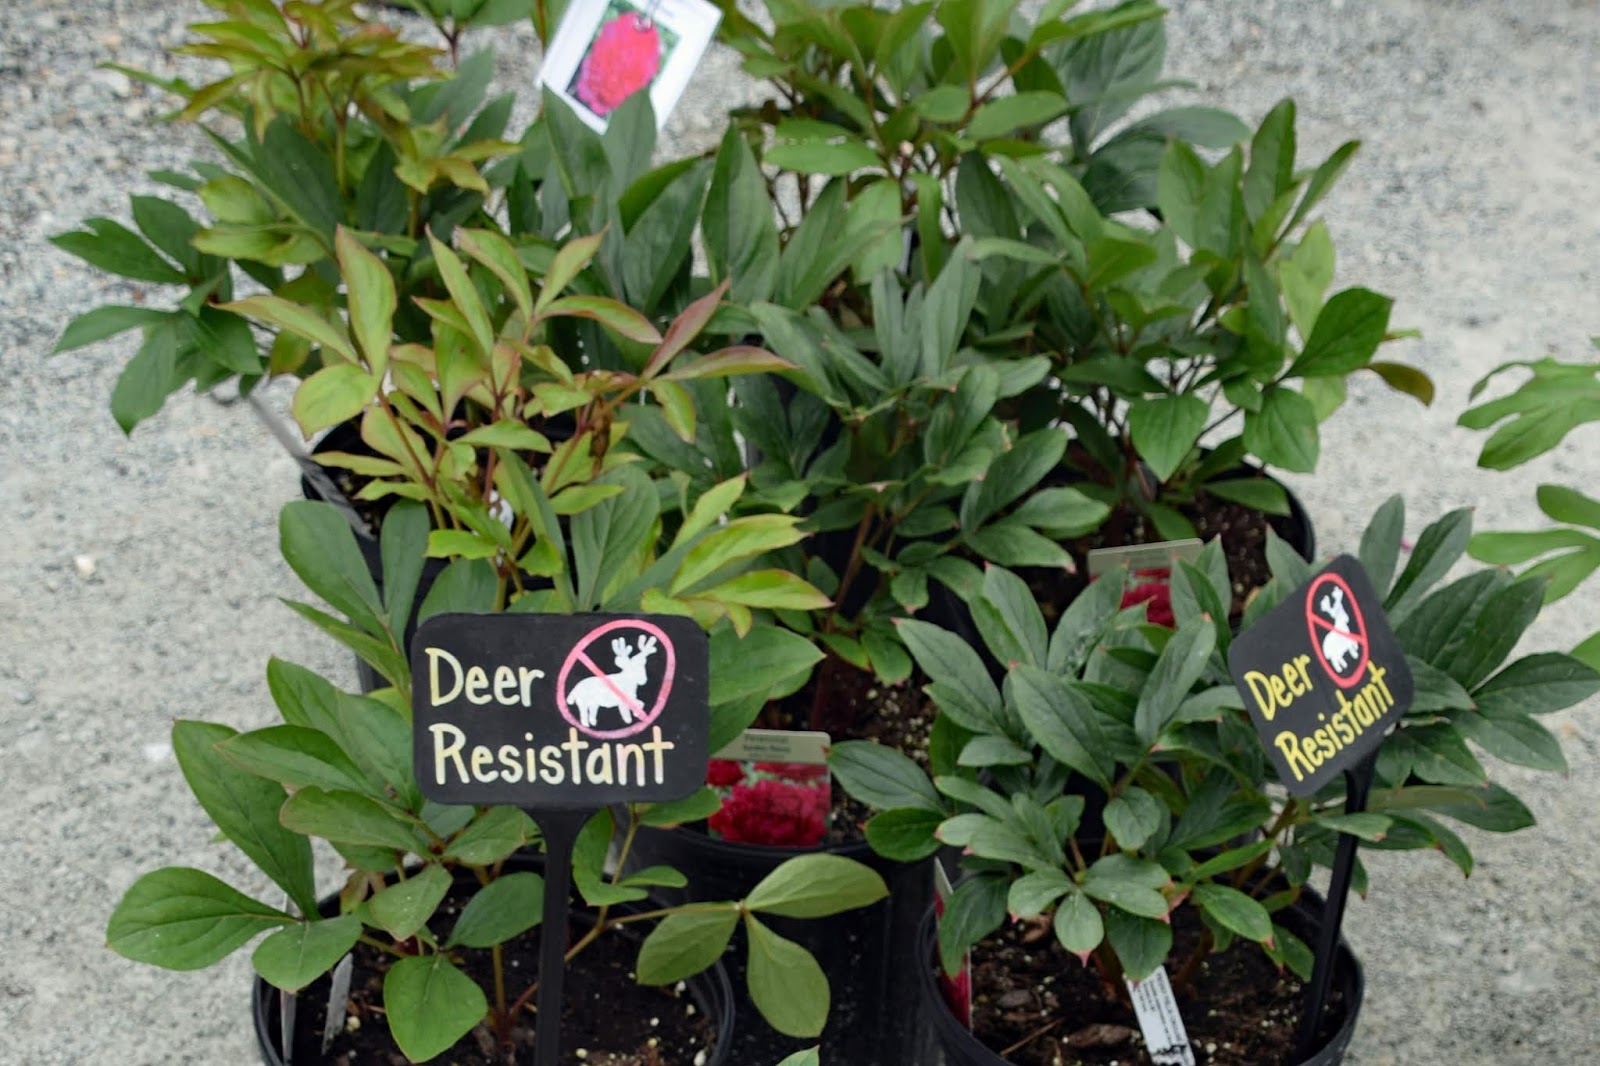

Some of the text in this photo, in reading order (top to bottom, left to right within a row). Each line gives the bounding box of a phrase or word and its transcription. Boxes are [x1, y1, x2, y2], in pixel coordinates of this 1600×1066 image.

[425, 647, 545, 707] Deer
[1244, 654, 1313, 721] Deer
[1274, 660, 1394, 781] Resistant
[428, 723, 675, 787] Resistant
